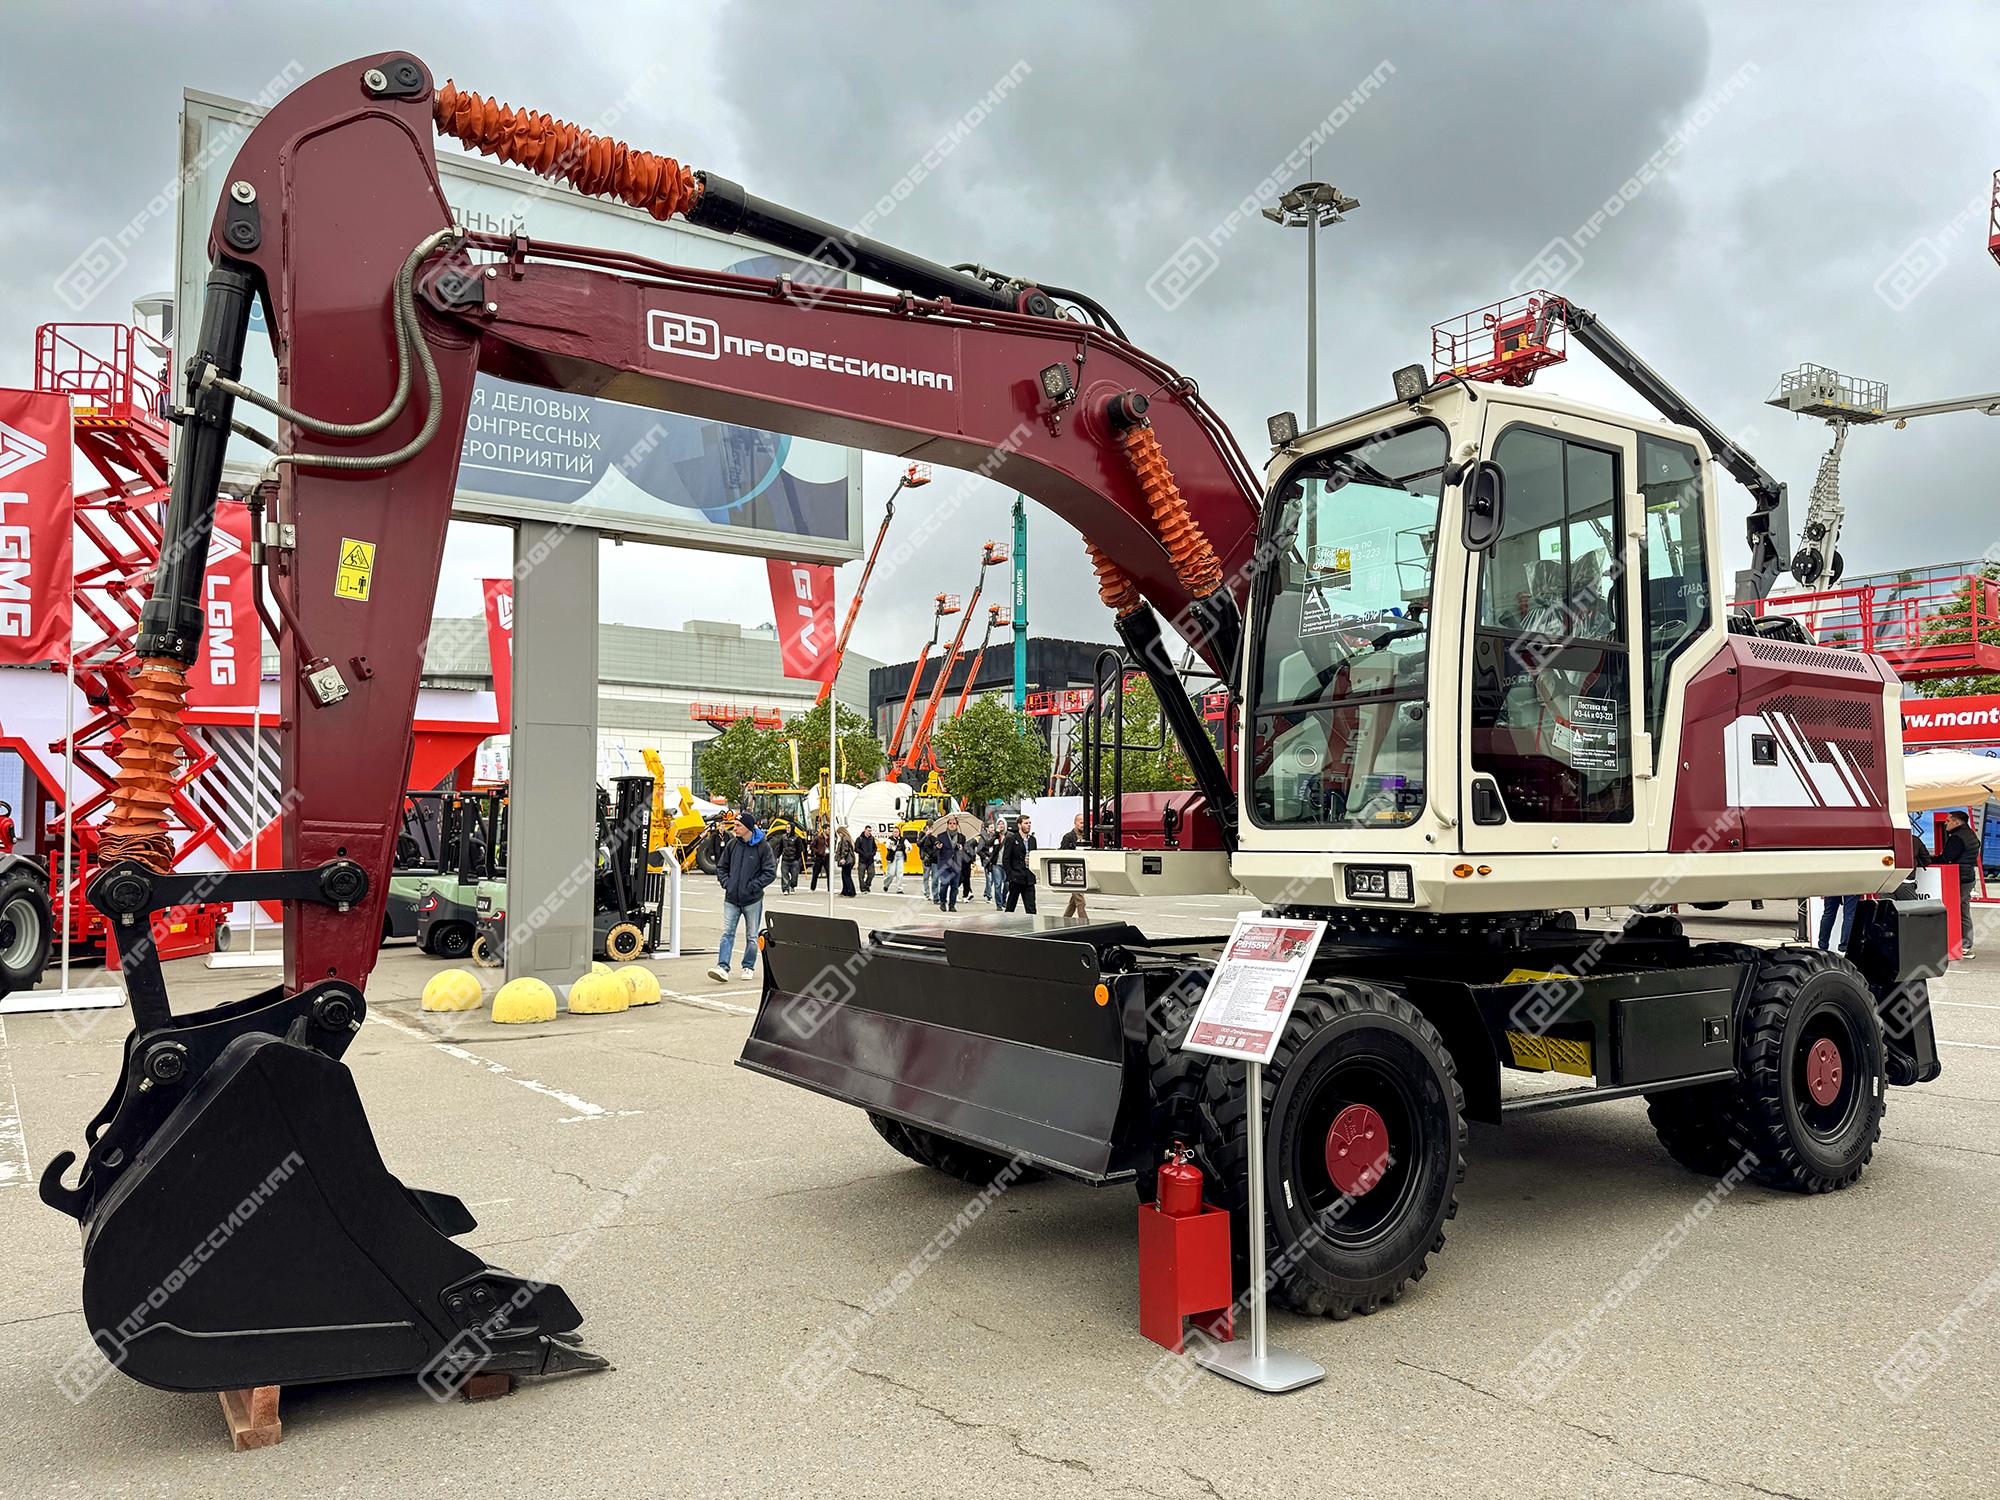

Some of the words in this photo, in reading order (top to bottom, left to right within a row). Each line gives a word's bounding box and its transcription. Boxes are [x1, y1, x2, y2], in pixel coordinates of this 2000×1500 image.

[724, 336, 953, 391] ПРОФЕССИОНАЛ
[467, 413, 601, 450] ОНГРЕССНЫХ
[491, 391, 590, 424] ДЕЛОВЫХ
[0, 492, 31, 637] LGMG
[207, 575, 236, 685] LGMG
